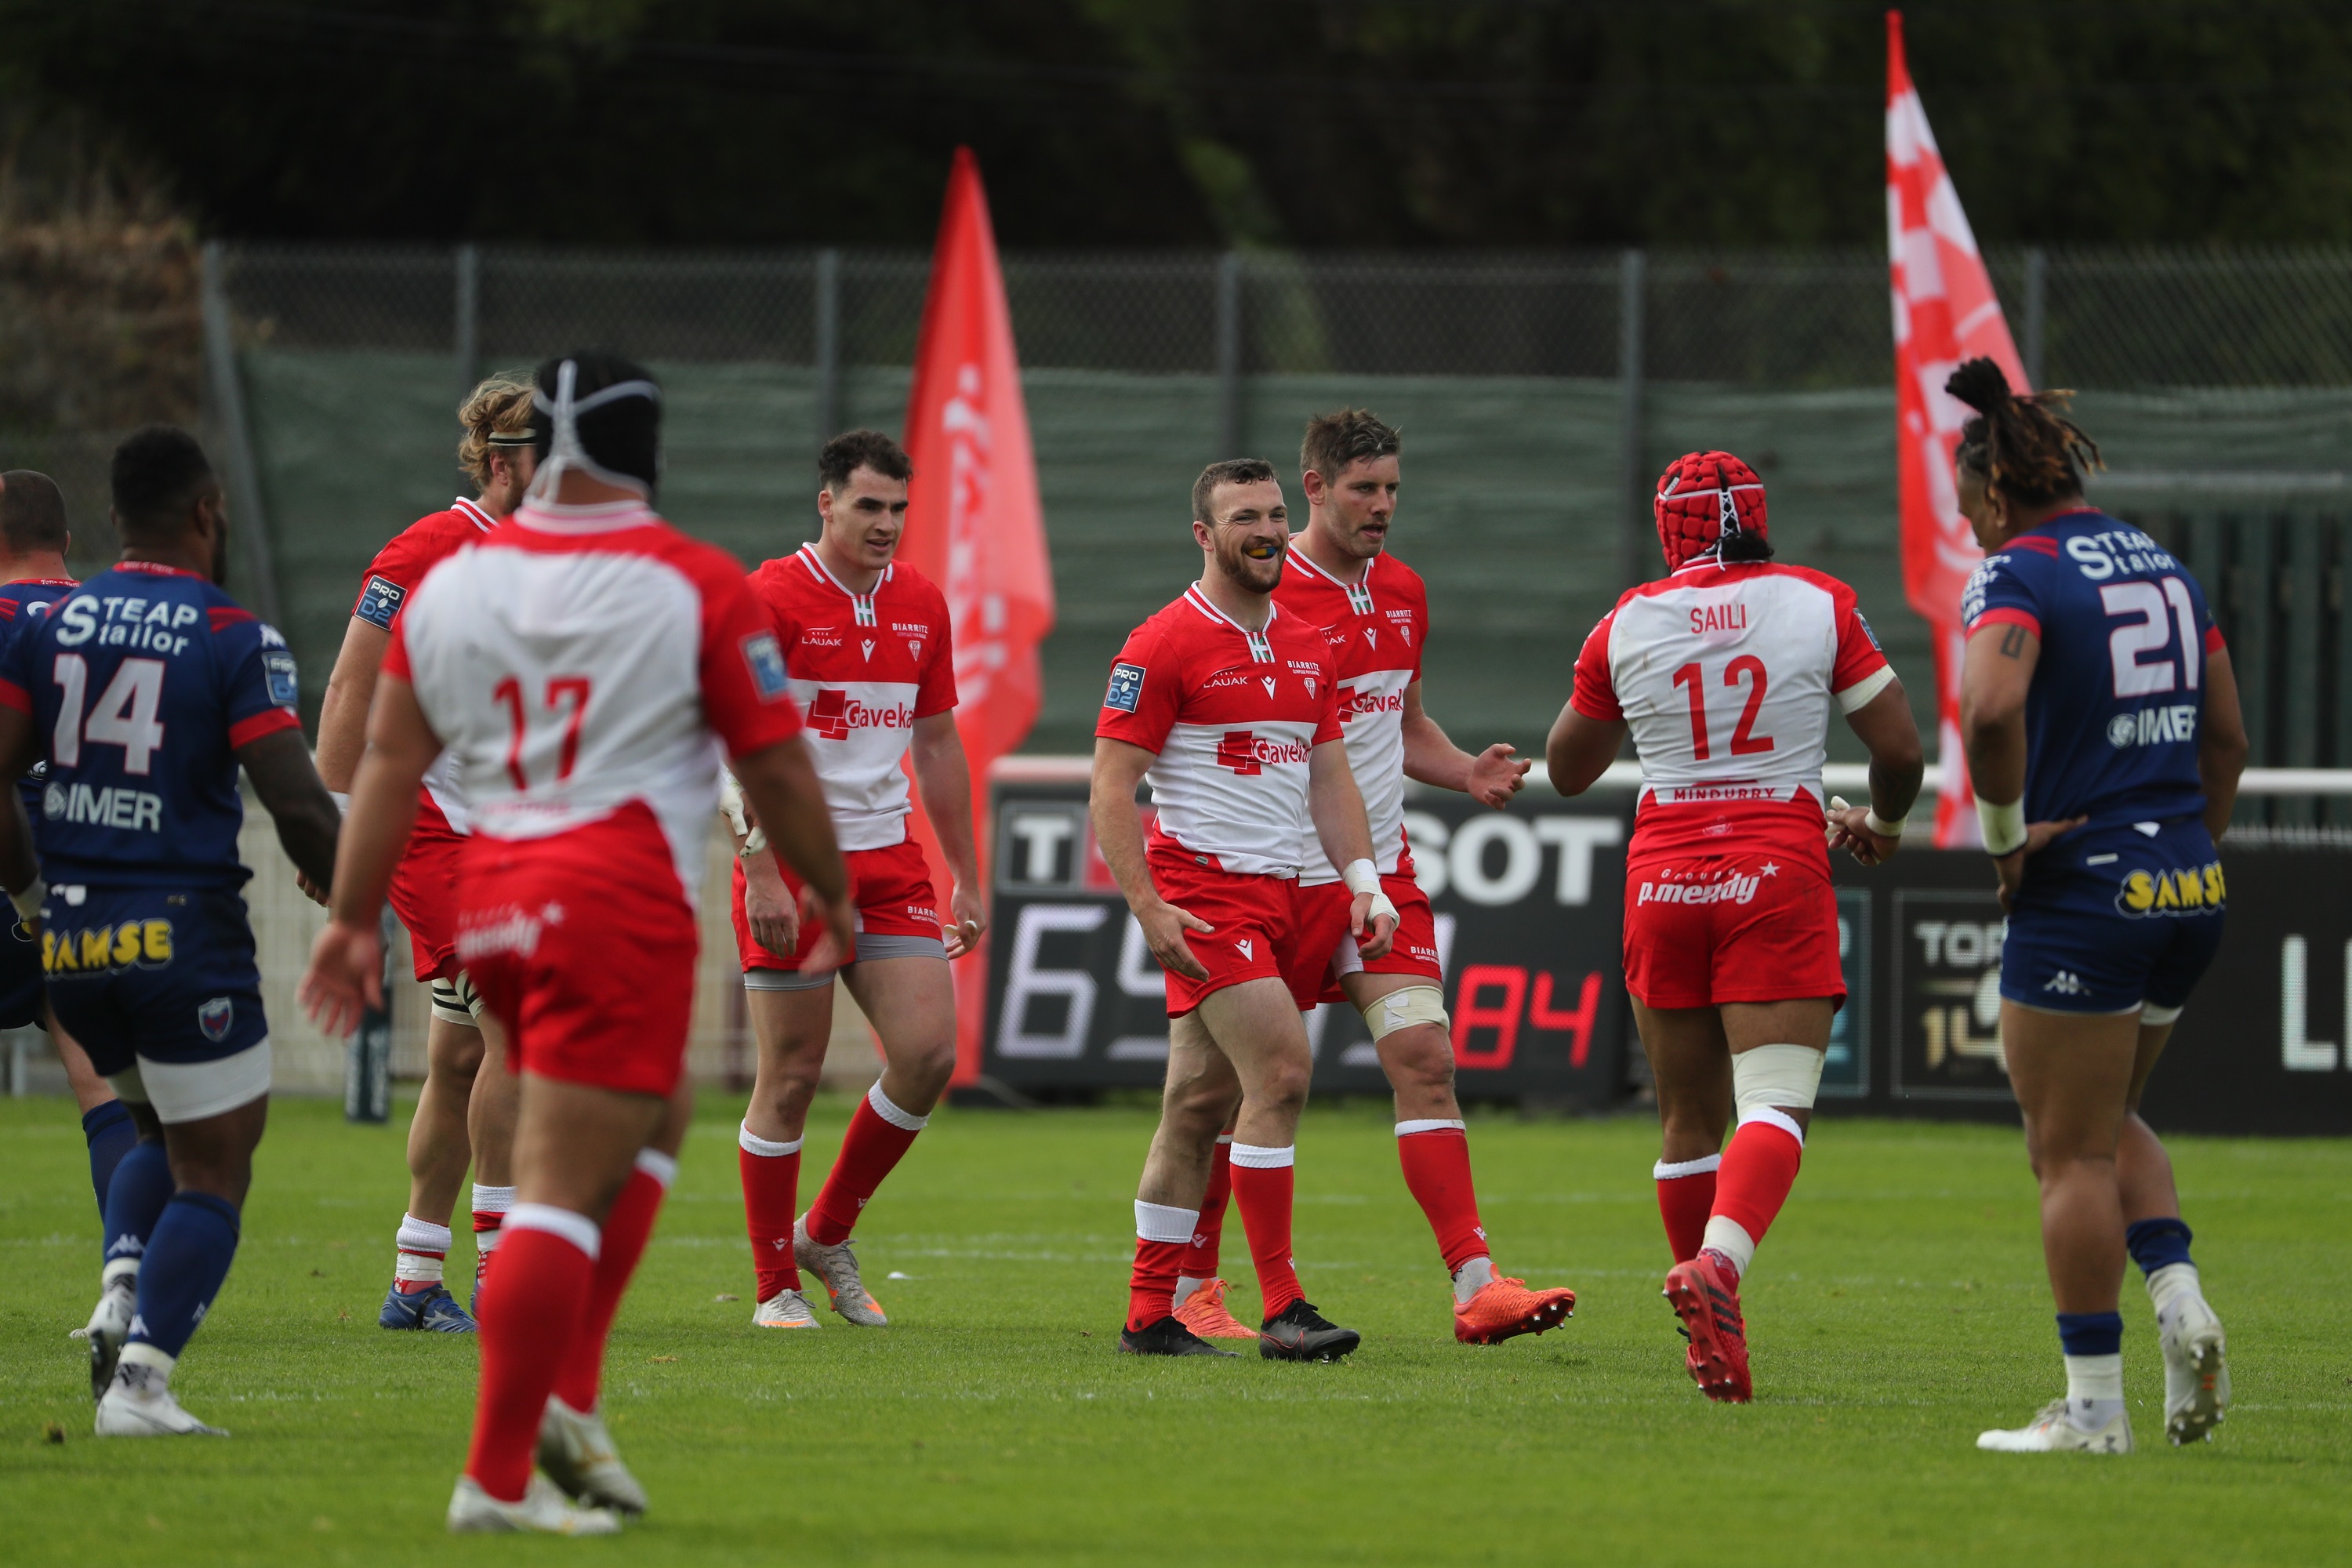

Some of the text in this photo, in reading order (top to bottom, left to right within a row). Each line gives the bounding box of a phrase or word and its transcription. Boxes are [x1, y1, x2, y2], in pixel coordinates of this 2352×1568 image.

[370, 581, 400, 601] PRO
[56, 594, 198, 647] STEAP
[360, 599, 391, 624] D2
[1385, 609, 1412, 619] BIARRITZ
[1690, 604, 1747, 634] SAILI
[891, 622, 928, 634] BIARRITZ
[2099, 575, 2199, 699] 21
[801, 636, 843, 647] LAUAK
[1114, 668, 1139, 681] PRO
[1287, 660, 1320, 672] BIARRITZ
[1203, 676, 1248, 688] LAUAK
[1107, 688, 1134, 706] D2
[1672, 654, 1775, 760] 12
[53, 652, 166, 776] 14
[492, 674, 592, 793] 17
[1674, 787, 1777, 800] MINDURRY
[66, 782, 163, 833] IMER
[1661, 867, 1736, 882] Groupe
[1637, 872, 1762, 907] p.mendy
[1450, 964, 1604, 1069] 84
